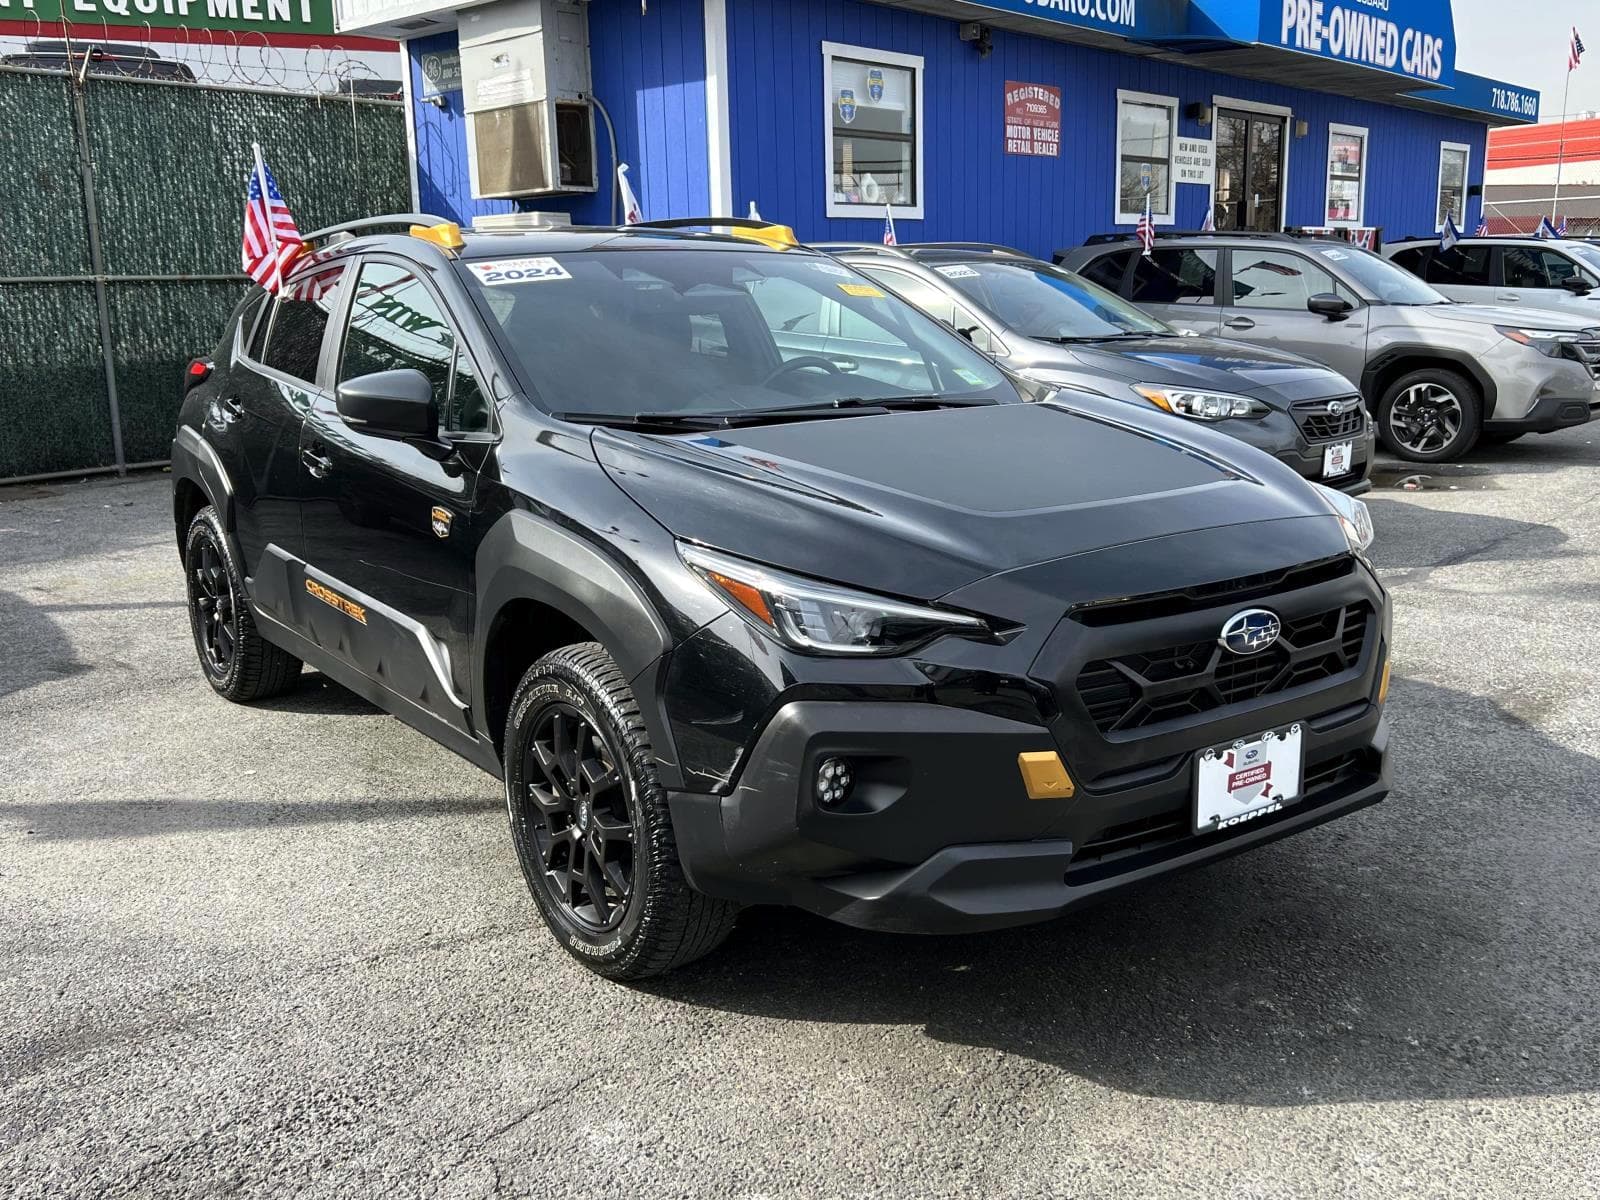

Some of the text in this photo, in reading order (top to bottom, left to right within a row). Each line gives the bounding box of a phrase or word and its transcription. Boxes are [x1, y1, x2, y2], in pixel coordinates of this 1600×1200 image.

[1024, 0, 1136, 27] RU.COM
[1356, 0, 1389, 11] ARU
[1281, 0, 1443, 80] PRE-OWNED CARS
[1006, 86, 1061, 110] REGISTERED
[1491, 87, 1537, 116] 718.786.1660
[1007, 116, 1023, 125] STATE
[1006, 125, 1059, 142] MOTOR VEHICLE
[1007, 139, 1058, 156] RETAIL DEALER
[1179, 143, 1208, 154] NEW AND USED
[1174, 155, 1192, 165] VEHICLES
[1193, 157, 1201, 167] ARE
[1181, 169, 1204, 179] ON THIS LOT
[484, 267, 563, 282] 2024
[305, 579, 368, 624] CROSSTREK
[1232, 773, 1267, 788] PRE-OWNED
[1235, 767, 1265, 780] CERTIFIED
[1217, 803, 1283, 830] KOEPPEL
